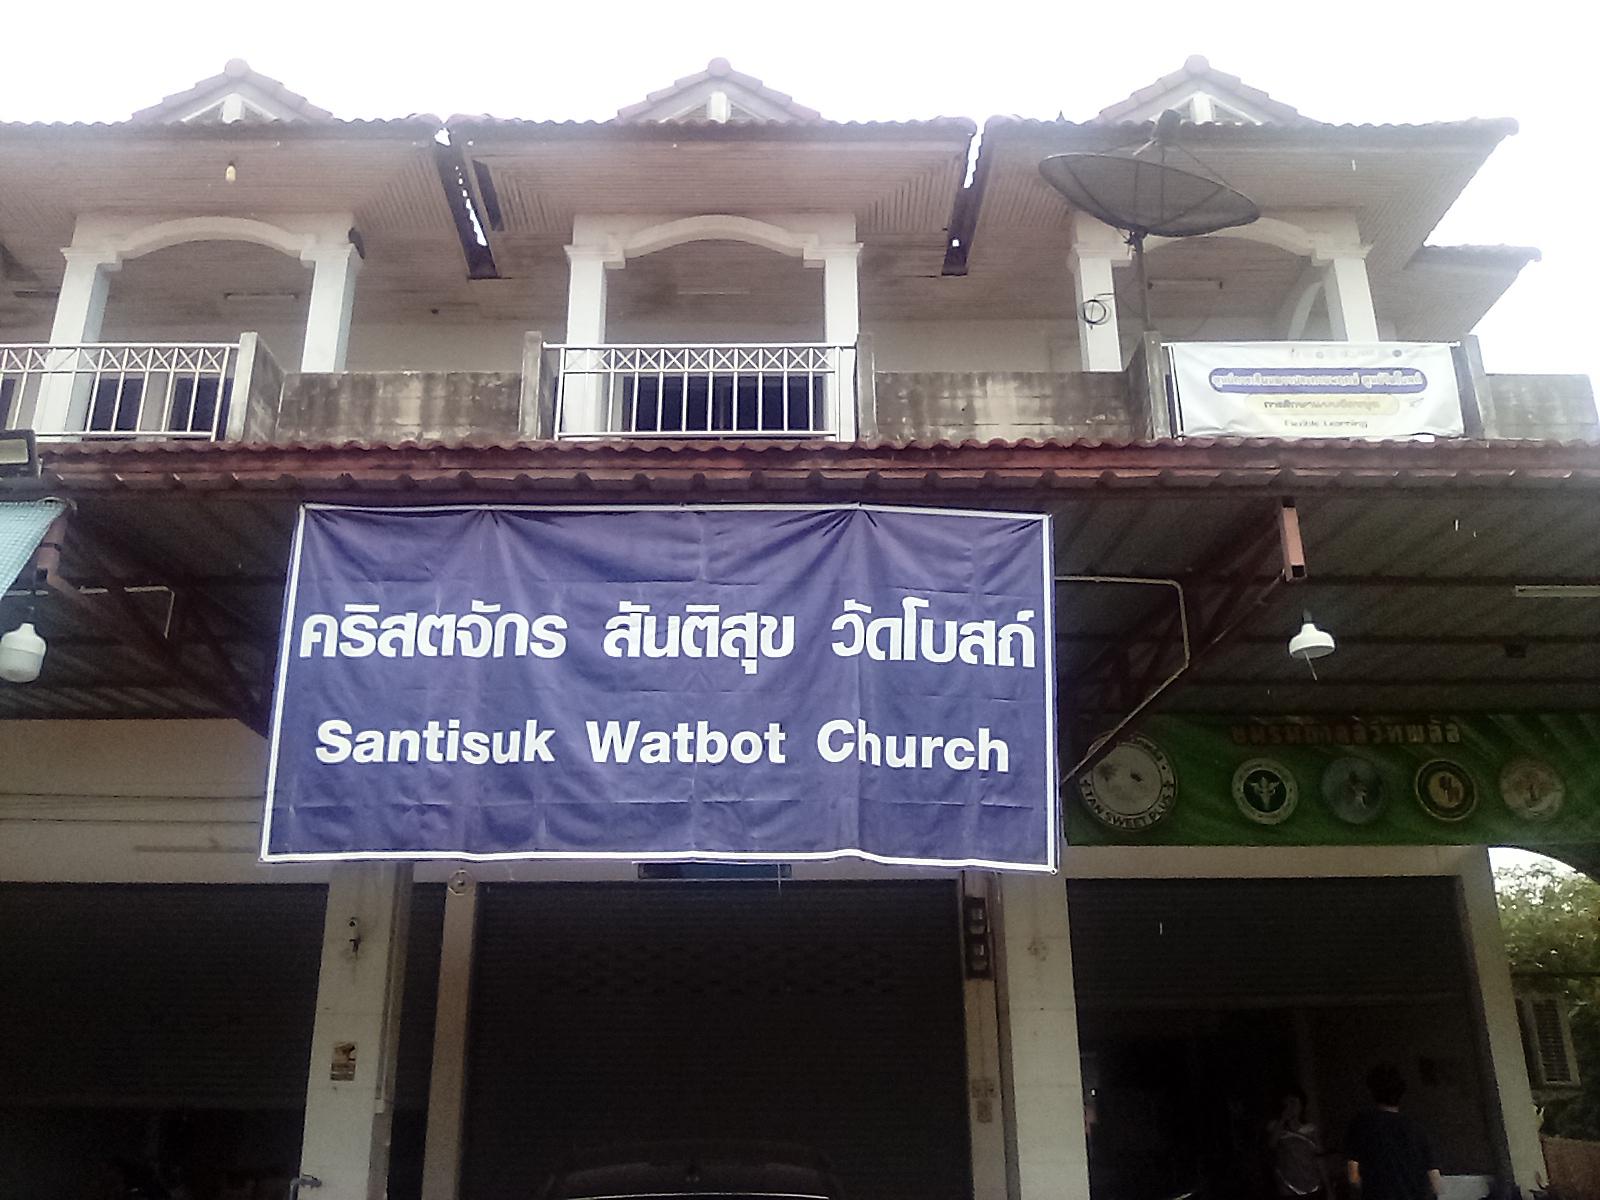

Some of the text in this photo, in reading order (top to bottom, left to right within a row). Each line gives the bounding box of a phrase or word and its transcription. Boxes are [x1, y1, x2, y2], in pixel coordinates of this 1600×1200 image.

[299, 596, 1038, 676] คริสตจักร สันติสุข วัดโบสถ์
[314, 717, 1010, 774] Santisuk Watbot Church
[1103, 811, 1147, 828] SWEET
